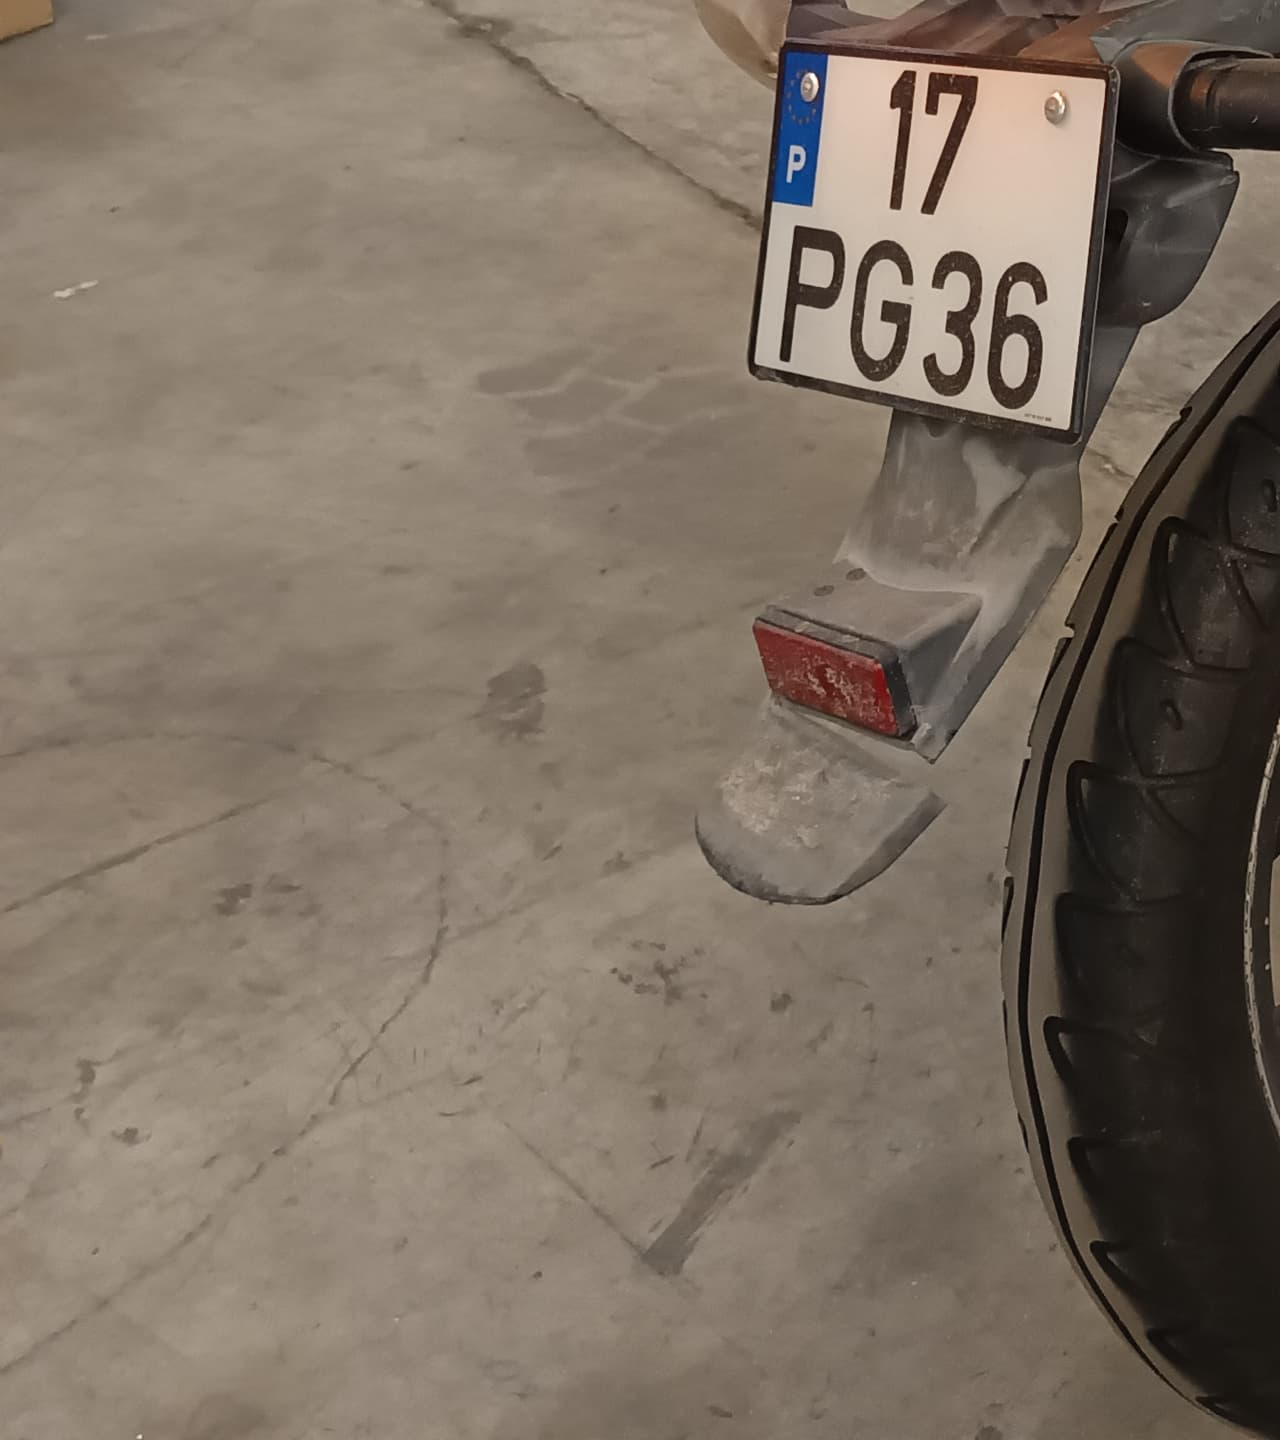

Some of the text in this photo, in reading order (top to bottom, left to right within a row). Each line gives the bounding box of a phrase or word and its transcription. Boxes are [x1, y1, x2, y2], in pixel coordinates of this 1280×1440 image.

[785, 144, 807, 184] P
[889, 69, 979, 216] 17
[779, 225, 1049, 410] PG36
